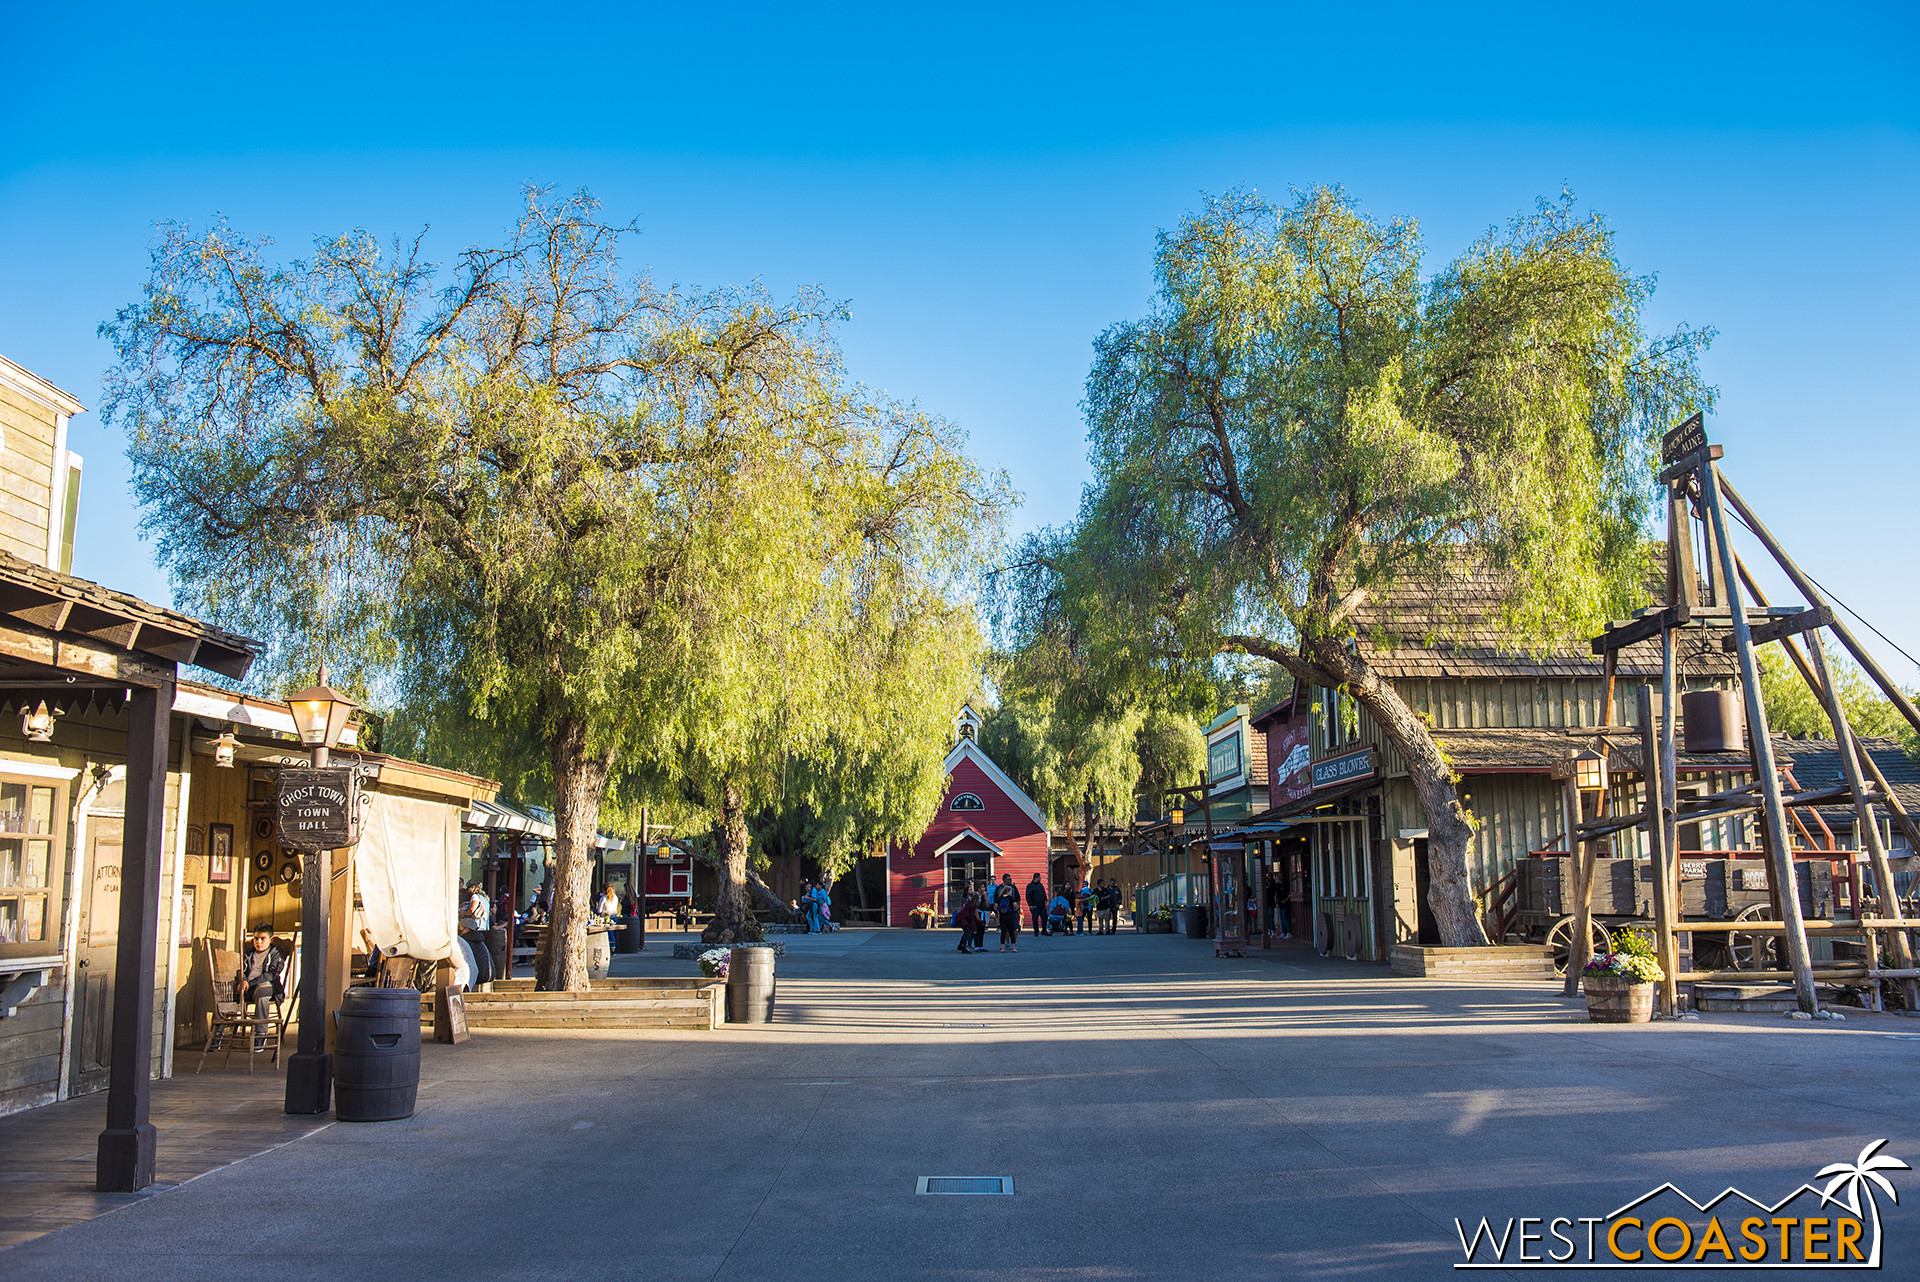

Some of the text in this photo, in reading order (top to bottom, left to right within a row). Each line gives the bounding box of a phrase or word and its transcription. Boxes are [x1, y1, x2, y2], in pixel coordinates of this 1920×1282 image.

[1681, 433, 1704, 454] MINE
[1315, 764, 1338, 781] GLASS
[280, 785, 347, 807] GHOST TOWN
[297, 808, 330, 817] TOWN
[299, 821, 329, 831] HALL
[102, 884, 110, 893] AT
